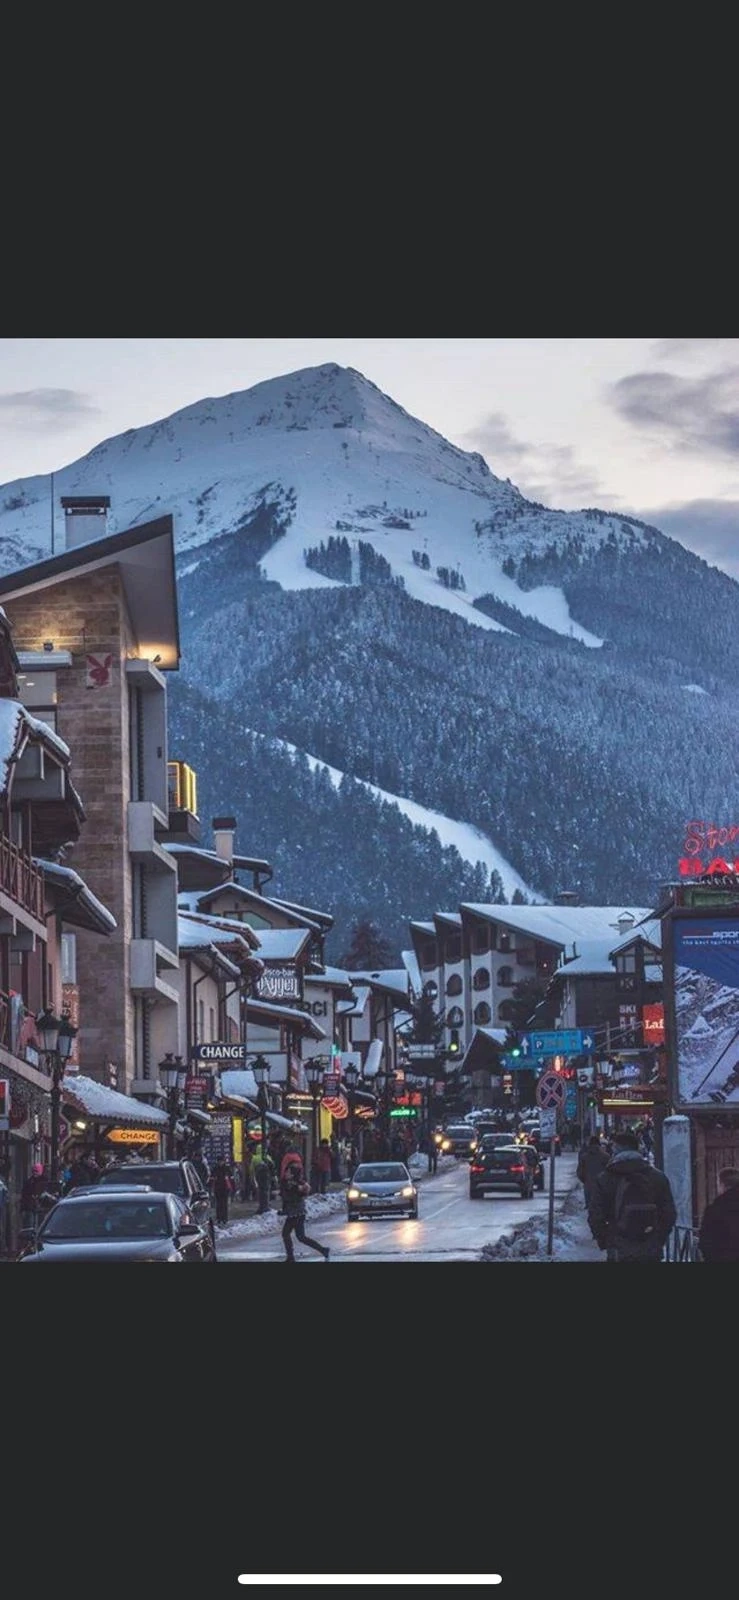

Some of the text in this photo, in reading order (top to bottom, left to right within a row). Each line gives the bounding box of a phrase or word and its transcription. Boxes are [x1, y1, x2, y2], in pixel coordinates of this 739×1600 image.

[679, 857, 739, 877] BA
[619, 1004, 637, 1014] SKI
[200, 1046, 244, 1058] CHANGE
[120, 1132, 156, 1141] CHANGE
